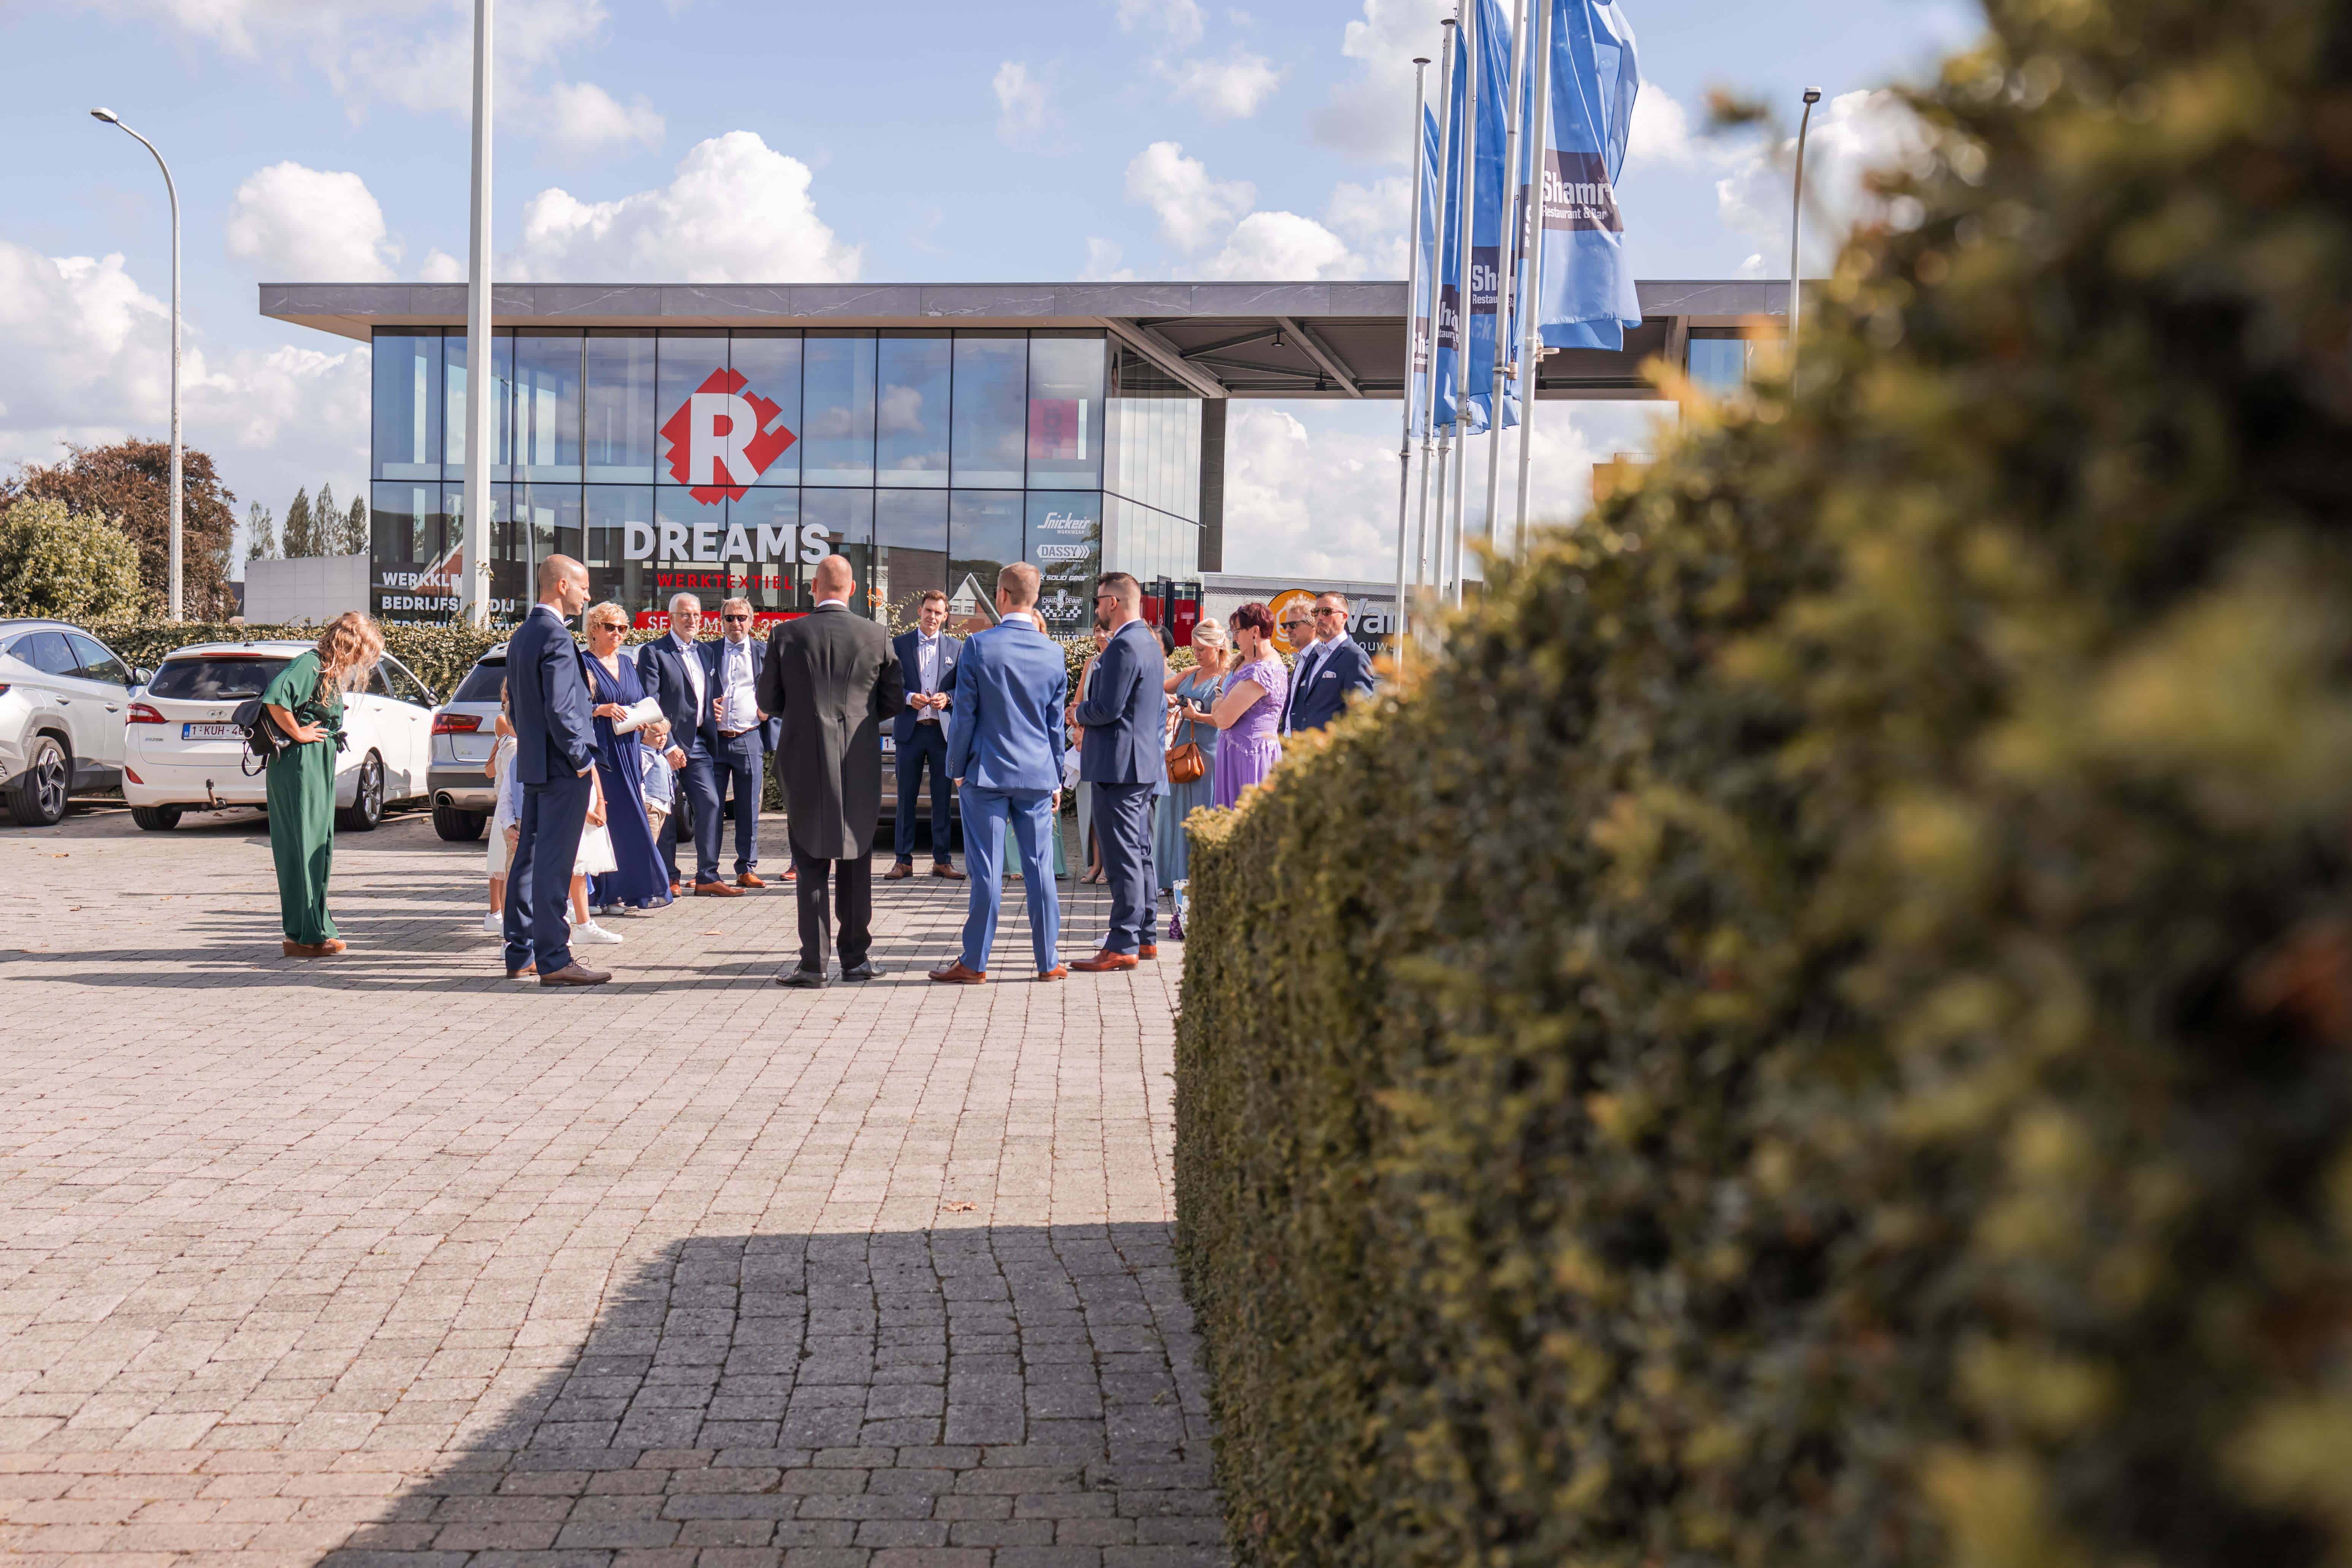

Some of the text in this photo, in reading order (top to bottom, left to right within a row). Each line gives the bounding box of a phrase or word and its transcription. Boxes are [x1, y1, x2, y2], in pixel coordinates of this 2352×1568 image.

[1542, 205, 1581, 219] Restaurant
[1591, 208, 1607, 220] Bar
[1472, 265, 1499, 292] Sh
[1472, 294, 1497, 304] Restau
[690, 393, 759, 485] R
[1037, 512, 1091, 529] Snickers
[624, 522, 830, 564] DREAMS
[1042, 546, 1077, 556] DASSY
[382, 572, 463, 587] WERKKLE
[657, 573, 793, 590] WERKTEXTIEL
[382, 596, 515, 612] BEDRIJFSDIJ
